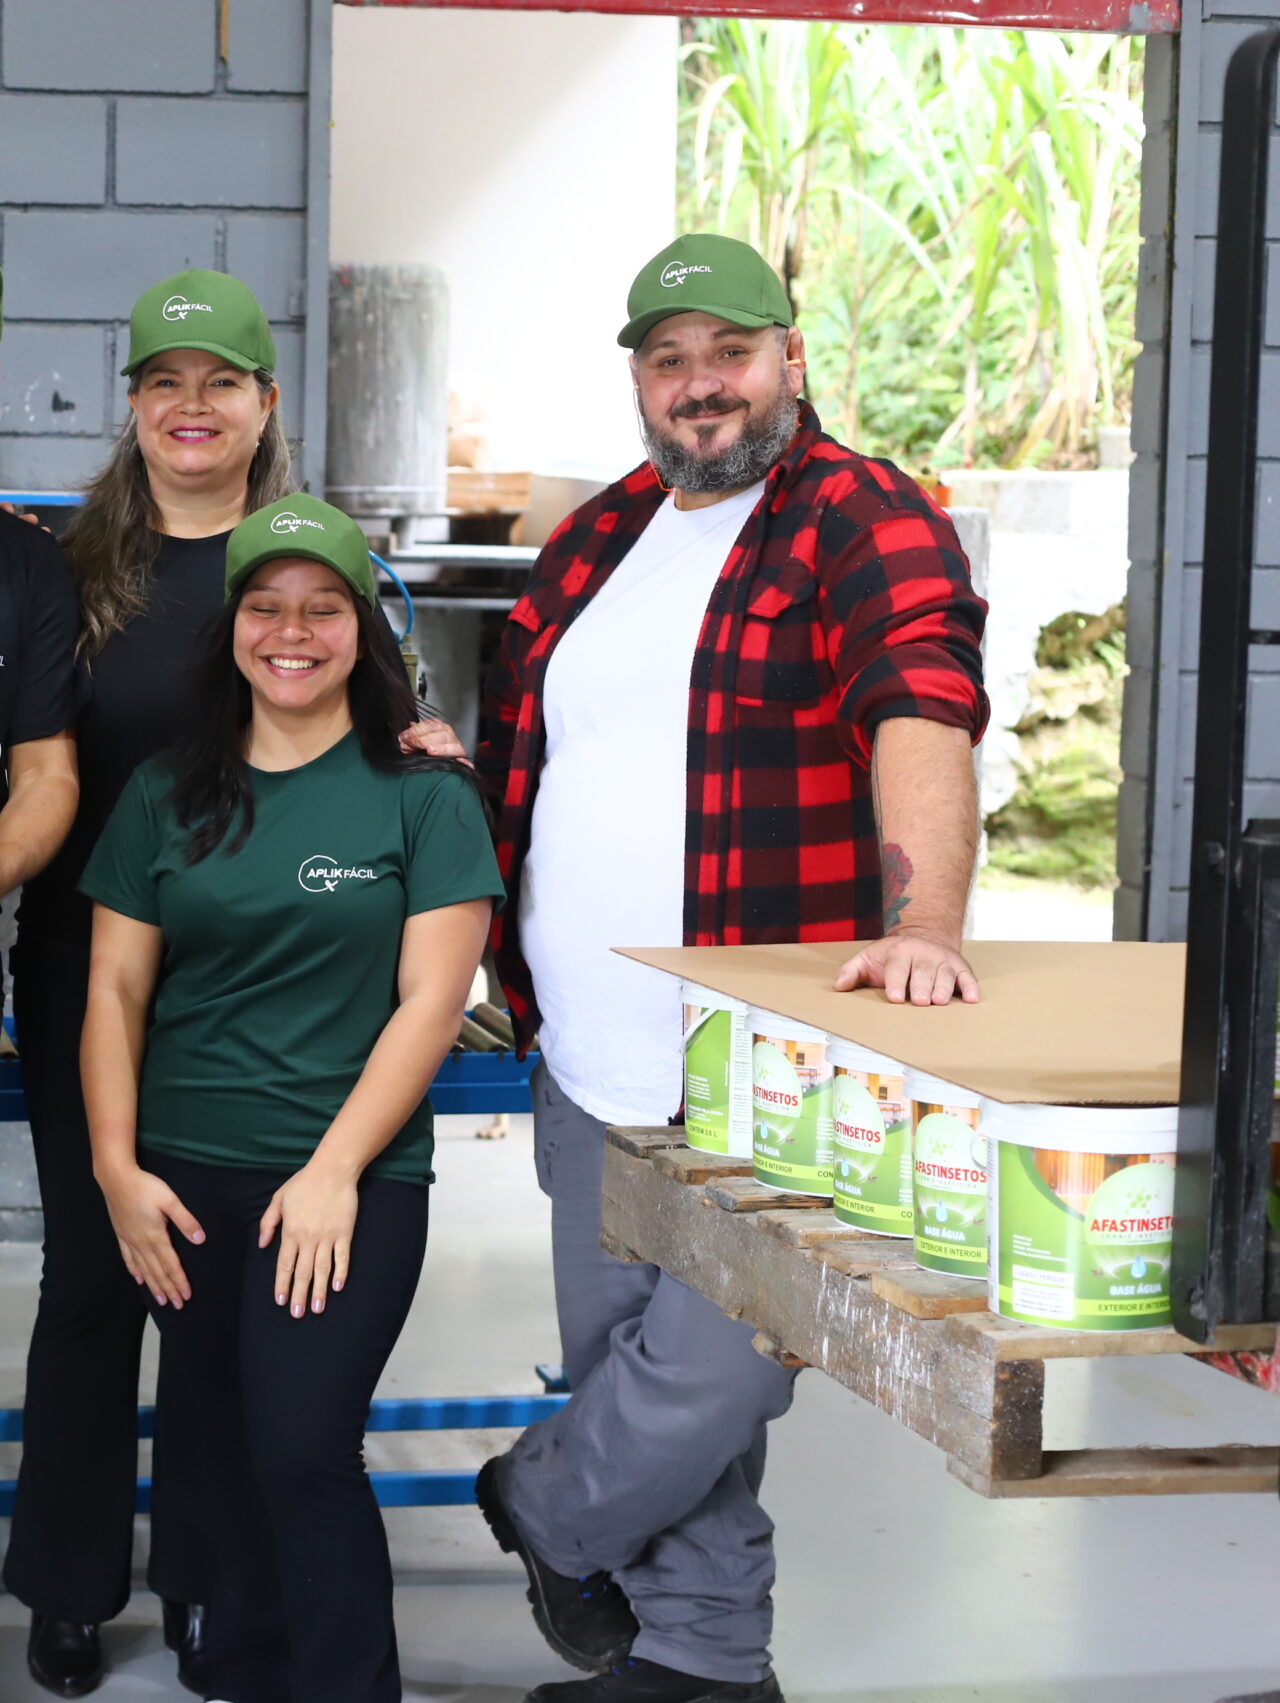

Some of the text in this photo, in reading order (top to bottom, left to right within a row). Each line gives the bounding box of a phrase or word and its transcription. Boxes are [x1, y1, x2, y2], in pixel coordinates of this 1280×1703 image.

[306, 866, 378, 880] APLIK FÁCIL
[915, 1160, 987, 1183] AFASTINSETOS
[949, 1248, 982, 1259] INTERIOR
[1110, 1282, 1162, 1296] BASE ÁGUA
[1098, 1304, 1137, 1312] EXTERIOR
